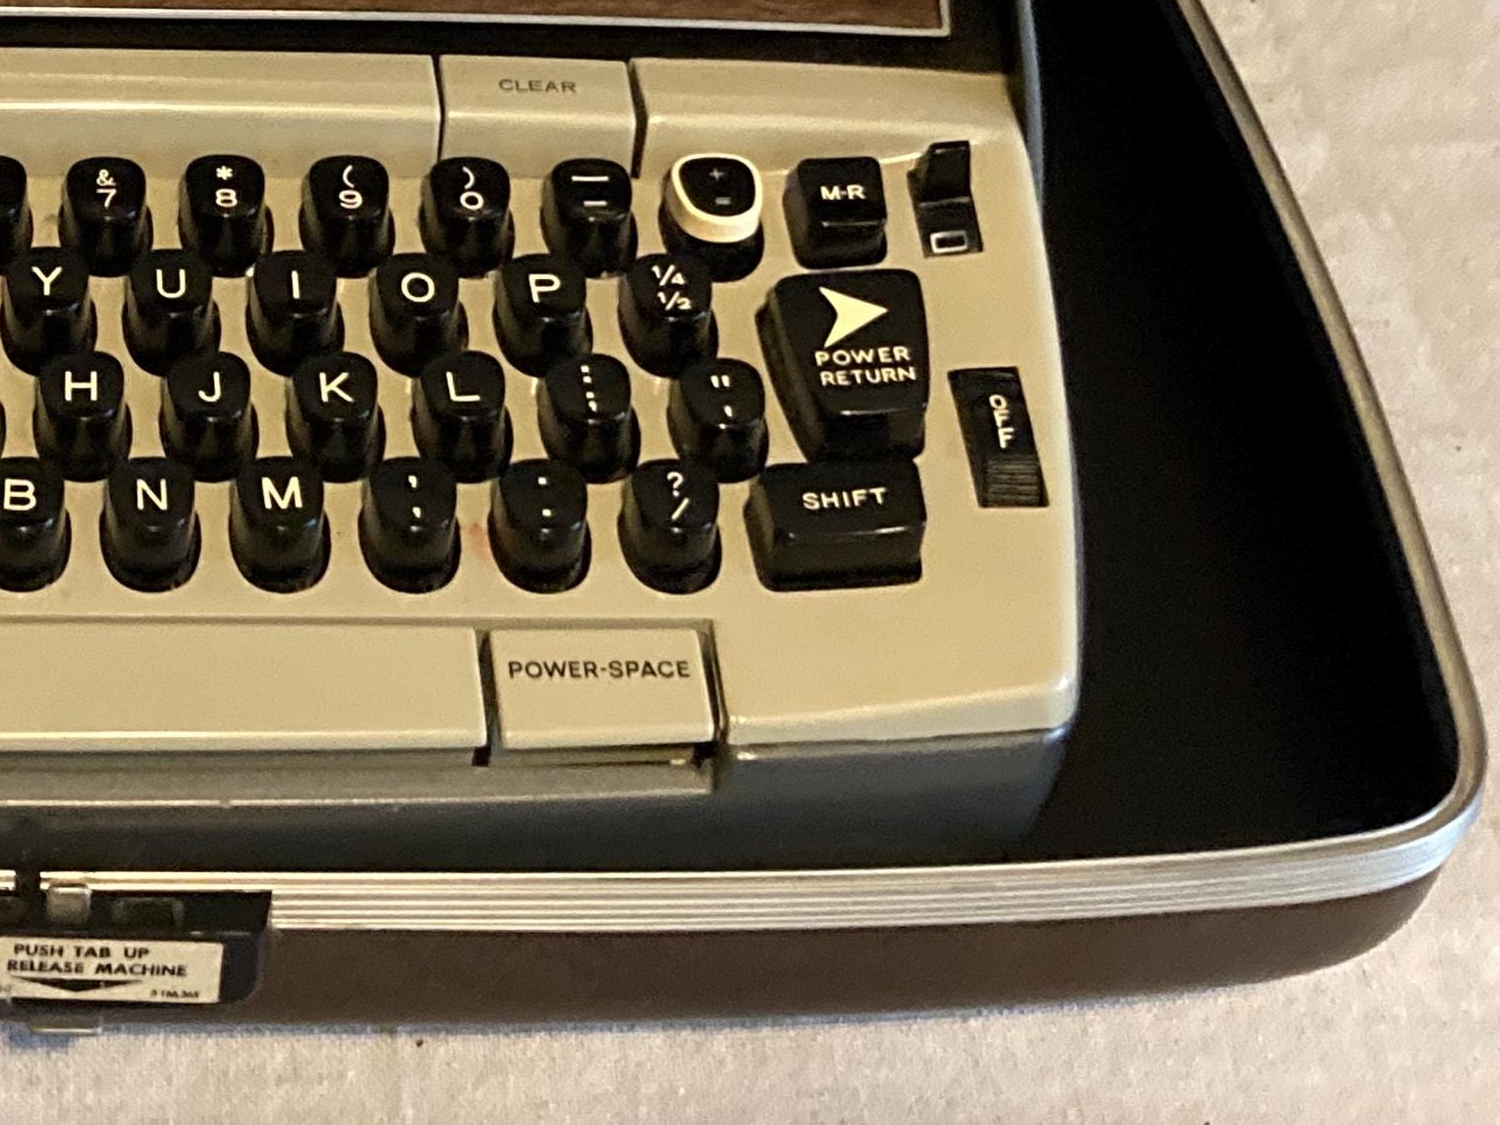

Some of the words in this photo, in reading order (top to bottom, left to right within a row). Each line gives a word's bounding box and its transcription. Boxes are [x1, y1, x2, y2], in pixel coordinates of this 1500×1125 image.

[498, 78, 578, 94] CLEAR
[96, 168, 116, 187] &
[96, 188, 117, 208] 7
[215, 188, 238, 208] 8
[338, 189, 363, 209] 9
[31, 266, 63, 296] Y
[156, 268, 186, 299] U
[291, 270, 301, 300] I
[400, 272, 435, 303] O
[528, 273, 561, 303] P
[814, 346, 911, 367] POWER
[64, 370, 98, 402] H
[198, 371, 222, 403] J
[319, 371, 354, 403] K
[445, 371, 481, 402] L
[819, 365, 917, 386] RETURN
[988, 394, 1015, 449] OFF
[3, 478, 37, 511] B
[136, 478, 168, 511] N
[261, 476, 303, 510] M
[666, 471, 684, 497] ?
[802, 487, 886, 510] SHIFT
[508, 660, 691, 679] POWER-SPACE
[13, 943, 64, 957] PUSH
[74, 945, 112, 959] TAB
[124, 947, 150, 960] UP
[7, 959, 85, 974] RELEASE
[95, 962, 188, 976] MACHINE
